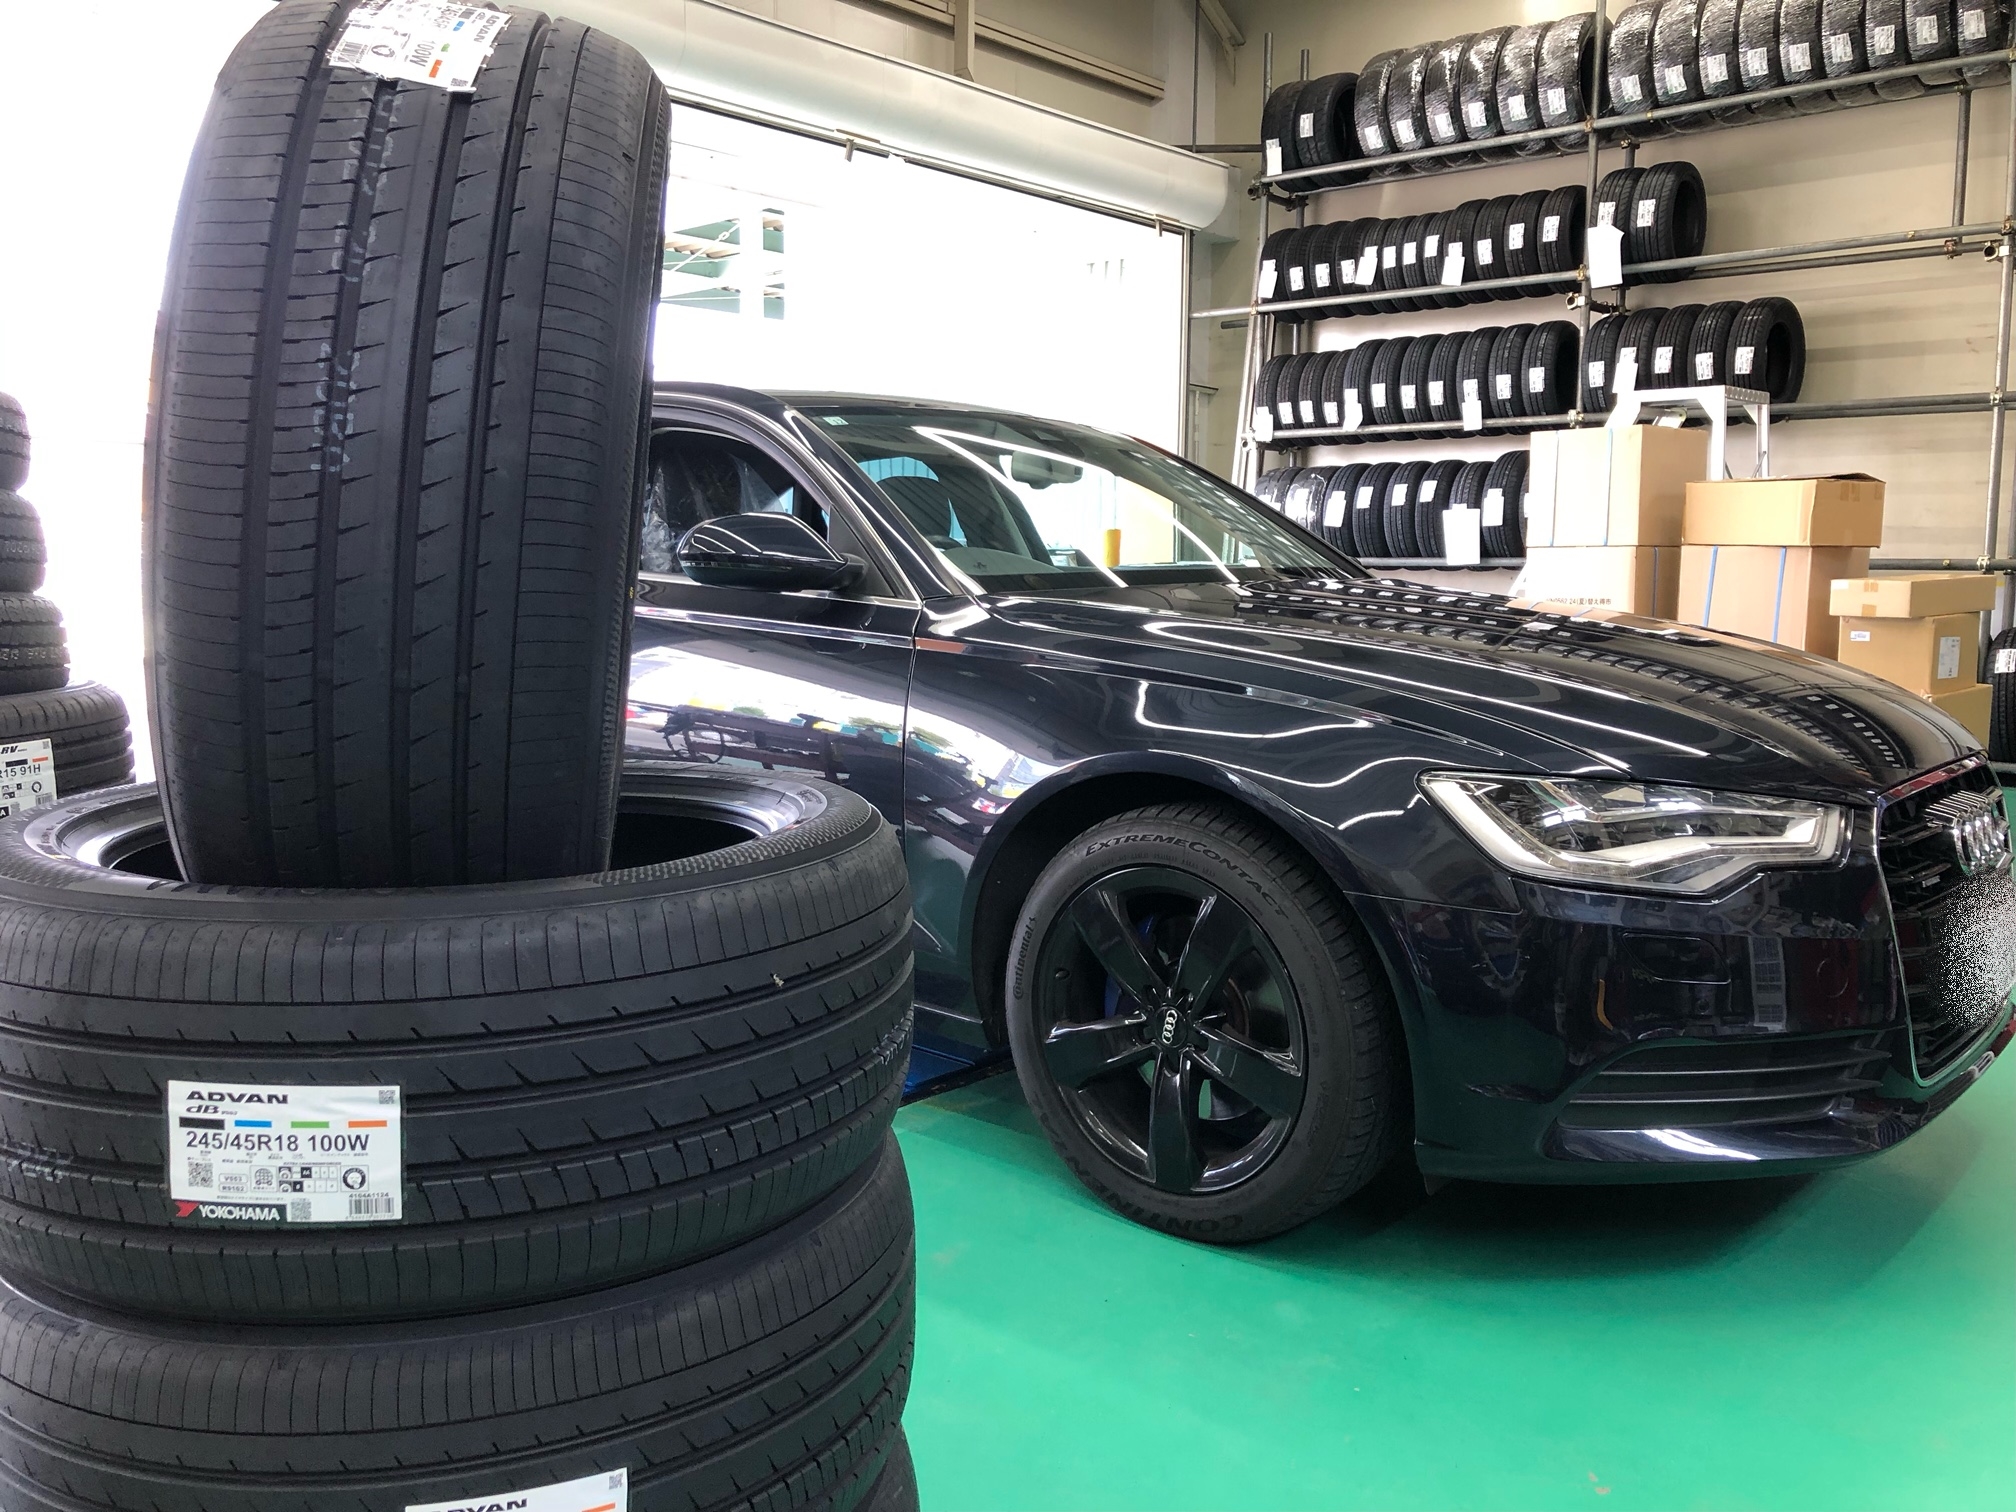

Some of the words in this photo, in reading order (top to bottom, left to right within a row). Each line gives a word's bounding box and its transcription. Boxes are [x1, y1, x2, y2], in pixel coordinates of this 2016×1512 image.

[409, 40, 436, 67] 100W
[0, 745, 18, 754] RV
[20, 763, 41, 776] 91H
[1012, 925, 1035, 1000] Continental
[186, 1090, 289, 1105] ADVAN
[186, 1104, 220, 1115] dB
[186, 1130, 299, 1151] 245/45R18
[308, 1133, 370, 1152] 100W
[199, 1204, 280, 1221] YOKOHAMA
